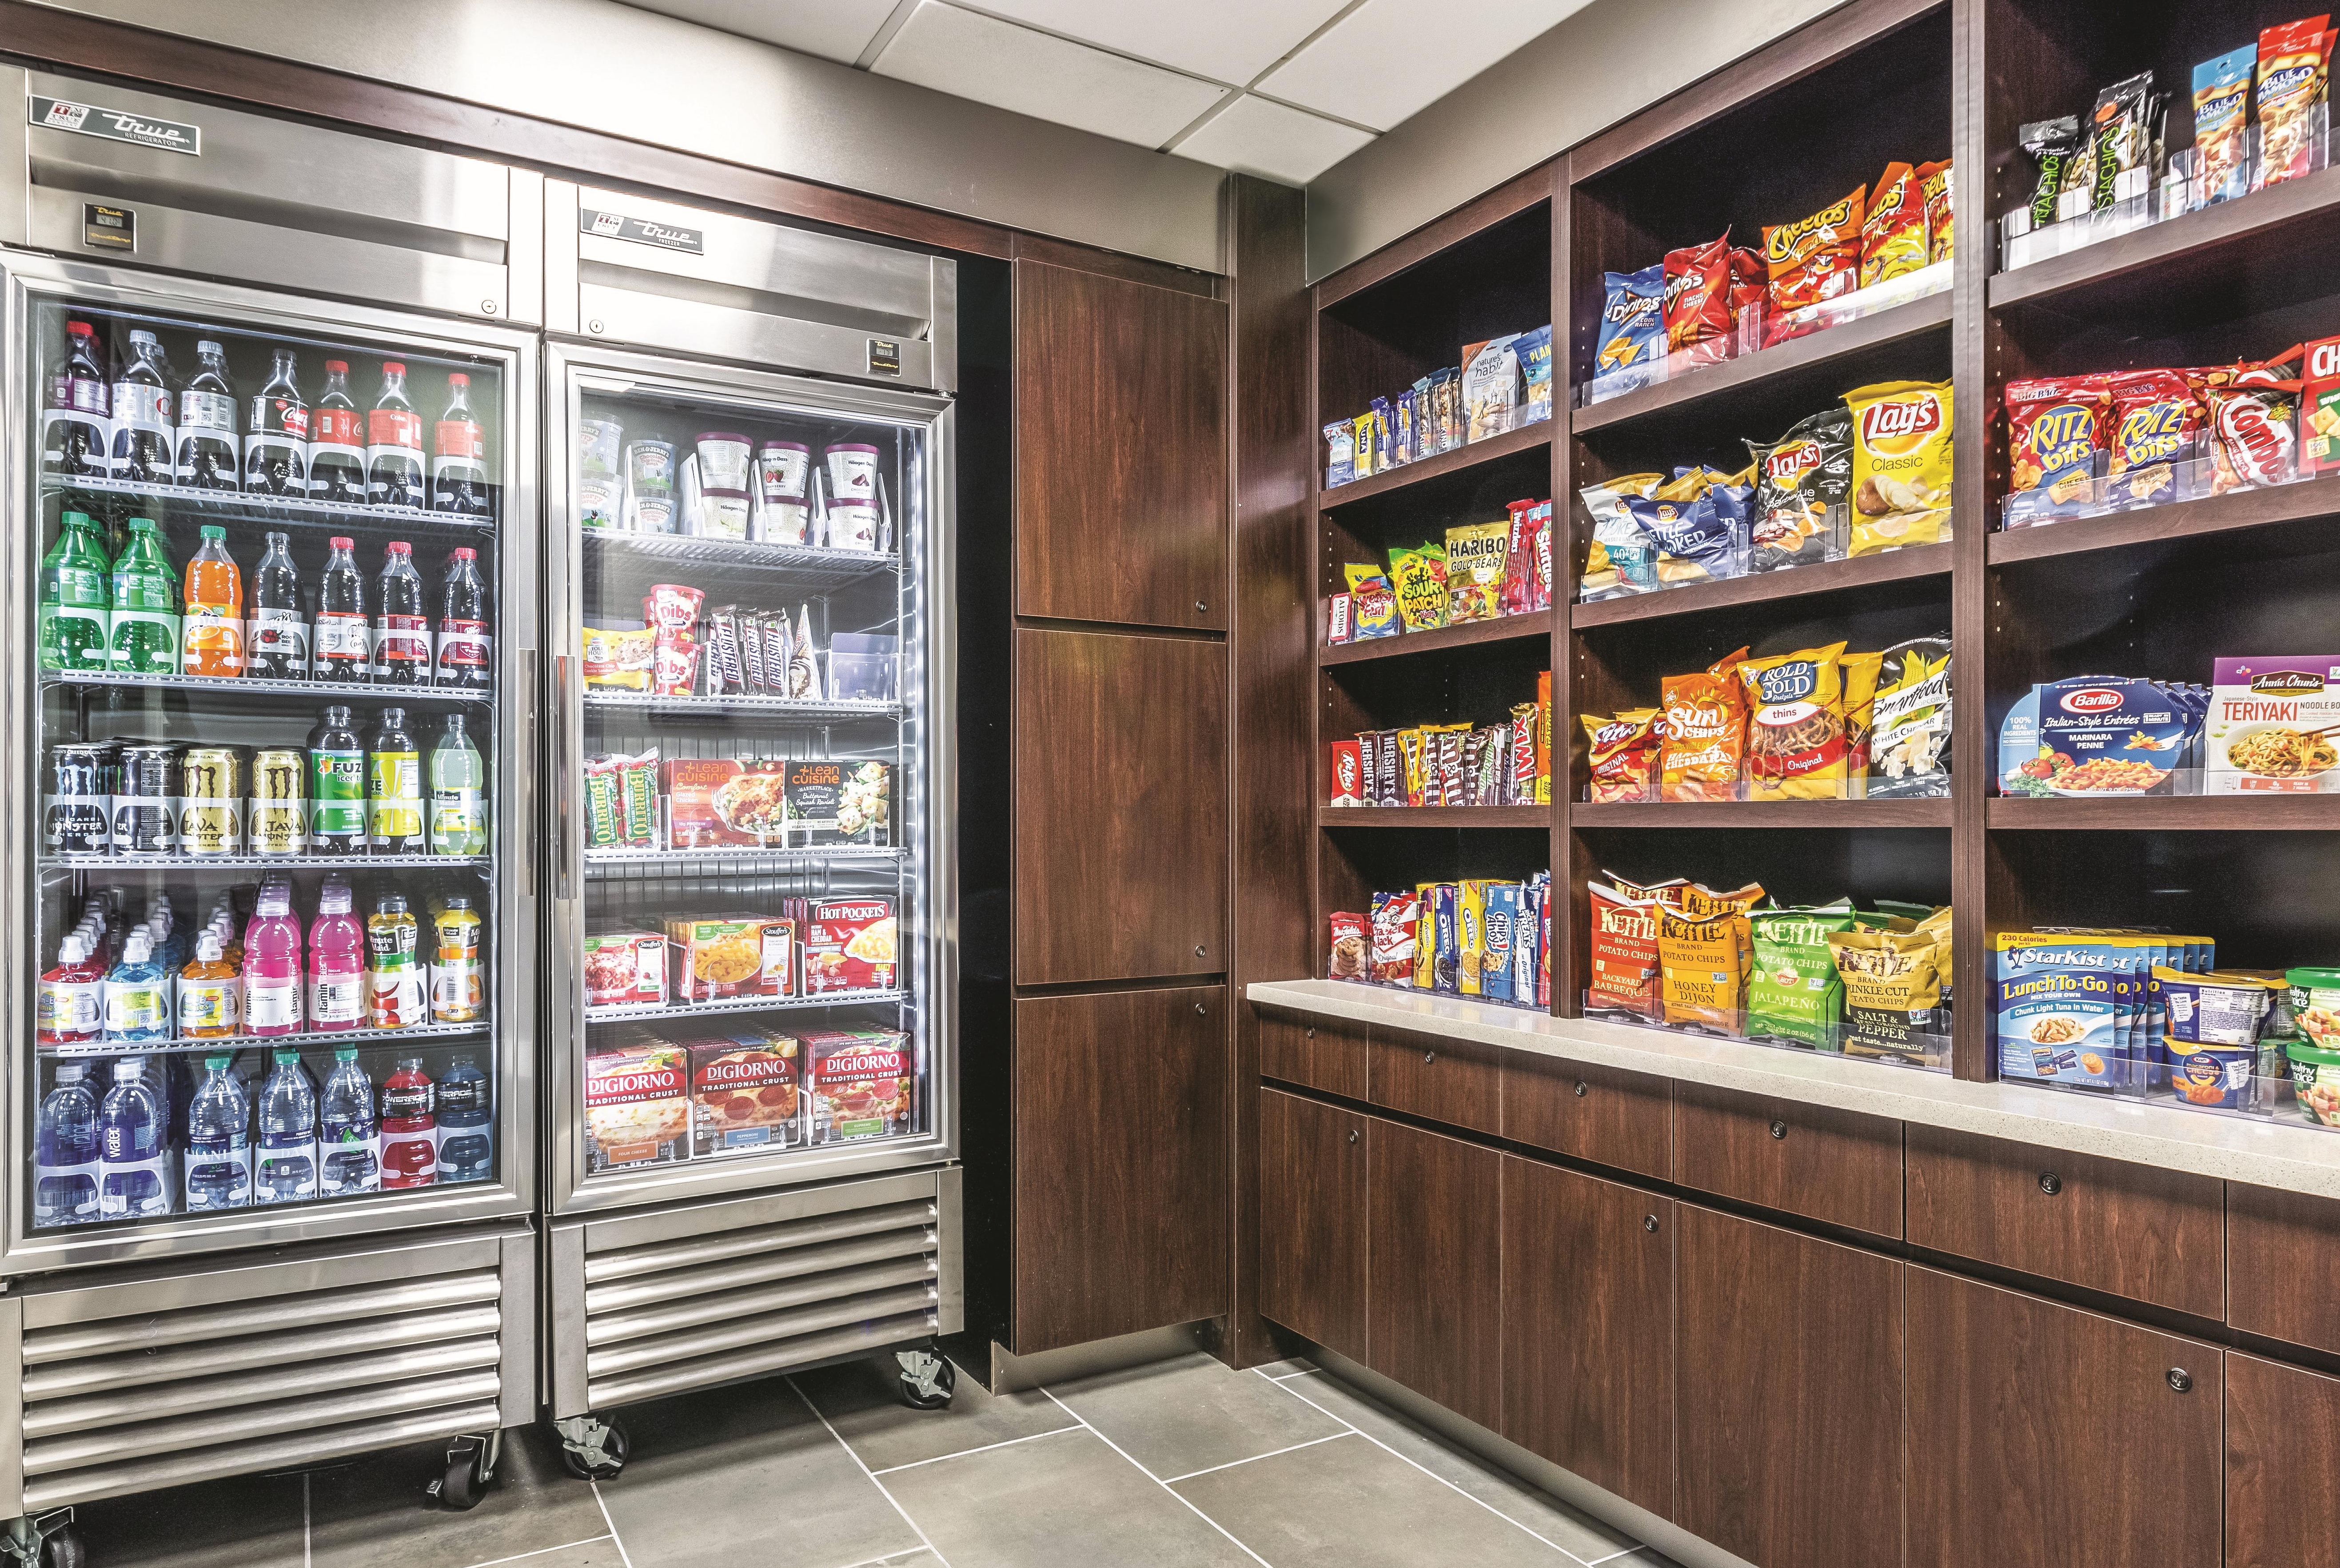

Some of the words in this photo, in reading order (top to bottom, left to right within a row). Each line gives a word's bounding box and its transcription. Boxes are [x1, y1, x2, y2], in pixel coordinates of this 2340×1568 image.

[2262, 68, 2296, 87] BLUE
[2200, 96, 2231, 112] BLUE
[102, 113, 185, 143] true
[124, 132, 177, 147] REFRIGERATOR
[633, 221, 694, 244] true
[1769, 201, 1849, 259] Cheetos
[658, 238, 680, 247] FREEZER
[1684, 292, 1703, 303] NACHO
[1610, 296, 1661, 323] Doritos
[2115, 388, 2133, 397] BIG
[2135, 383, 2155, 394] BAG
[1867, 403, 1934, 439] Lay's
[2120, 403, 2185, 447] RITZ
[1360, 424, 1368, 451] LUNA
[2031, 411, 2093, 454] RITZ
[2128, 435, 2179, 465] bits
[2231, 404, 2288, 482] Combos
[1873, 455, 1922, 471] Classic
[2042, 442, 2090, 471] bits
[2059, 476, 2090, 489] CHEESE
[1450, 537, 1506, 557] HARIBO
[1451, 557, 1502, 572] GOLD-BEARS
[1404, 581, 1440, 598] SOUR
[1364, 603, 1385, 619] Fish
[1405, 594, 1442, 613] PATCH
[661, 605, 692, 621] Dibs
[656, 660, 686, 675] Dibs
[1763, 662, 1807, 682] ROLD
[1761, 676, 1810, 700] GOLD
[2252, 676, 2284, 689] Annie
[2287, 675, 2322, 687] Chun's
[1772, 693, 1793, 702] Pretzels
[1874, 671, 1948, 715] Smartfood
[2075, 692, 2118, 706] Barilla
[1773, 709, 1796, 718] thins
[2223, 702, 2297, 721] TERIYAKI
[1667, 706, 1727, 741] Sun
[2044, 714, 2101, 729] Italian-Style
[2105, 715, 2140, 725] Entrées
[1684, 727, 1725, 737] CHIPS
[1873, 732, 1898, 746] WHITE
[1514, 715, 1535, 782] TWIX
[1362, 742, 1373, 792] HERSHEY'S
[1384, 737, 1395, 794] HERSHEY'S
[1598, 753, 1629, 774] ORIGINAL
[1788, 753, 1823, 770] Original
[590, 778, 611, 842] BURRITO
[629, 772, 648, 835] BURRITO
[265, 820, 301, 832] JAVA
[820, 908, 842, 919] HOT
[842, 905, 885, 918] POCKETS
[765, 927, 788, 935] Stouffer's
[1439, 913, 1450, 954] OREO
[1463, 908, 1474, 949] OREO
[1518, 911, 1530, 949] TREATS
[1660, 916, 1725, 942] KETTLE
[1758, 916, 1833, 946] KETTLE
[1376, 936, 1393, 948] Jack
[1615, 938, 1640, 947] BRAND
[1599, 945, 1628, 957] POTATO
[1631, 951, 1658, 961] CHIPS
[1663, 951, 1694, 962] POTATO
[1839, 946, 1912, 976] KETTLE
[2024, 948, 2107, 967] StarKist
[1756, 954, 1794, 966] POTATO
[1796, 959, 1827, 970] CHIPS
[1522, 961, 1530, 989] Original
[1602, 973, 1642, 986] BACKYARD
[1594, 981, 1650, 998] BARBEQUE
[1674, 981, 1716, 993] HONEY
[1886, 987, 1909, 996] CUT
[2002, 975, 2051, 1000] Lunch
[2056, 975, 2108, 992] To-Go
[1680, 992, 1715, 1004] DIJON
[1754, 992, 1819, 1010] JALAPEÑO
[1858, 1011, 1887, 1022] SALT
[2015, 1006, 2034, 1016] Chunk
[2037, 1004, 2053, 1013] Light
[2082, 1004, 2104, 1013] Water
[1858, 1025, 1907, 1040] PEPPER
[702, 1080, 759, 1091] TRADITIONAL
[822, 1073, 875, 1082] TRADITIONAL
[383, 1093, 427, 1103] POWERADE
[650, 1089, 678, 1098] CRUST
